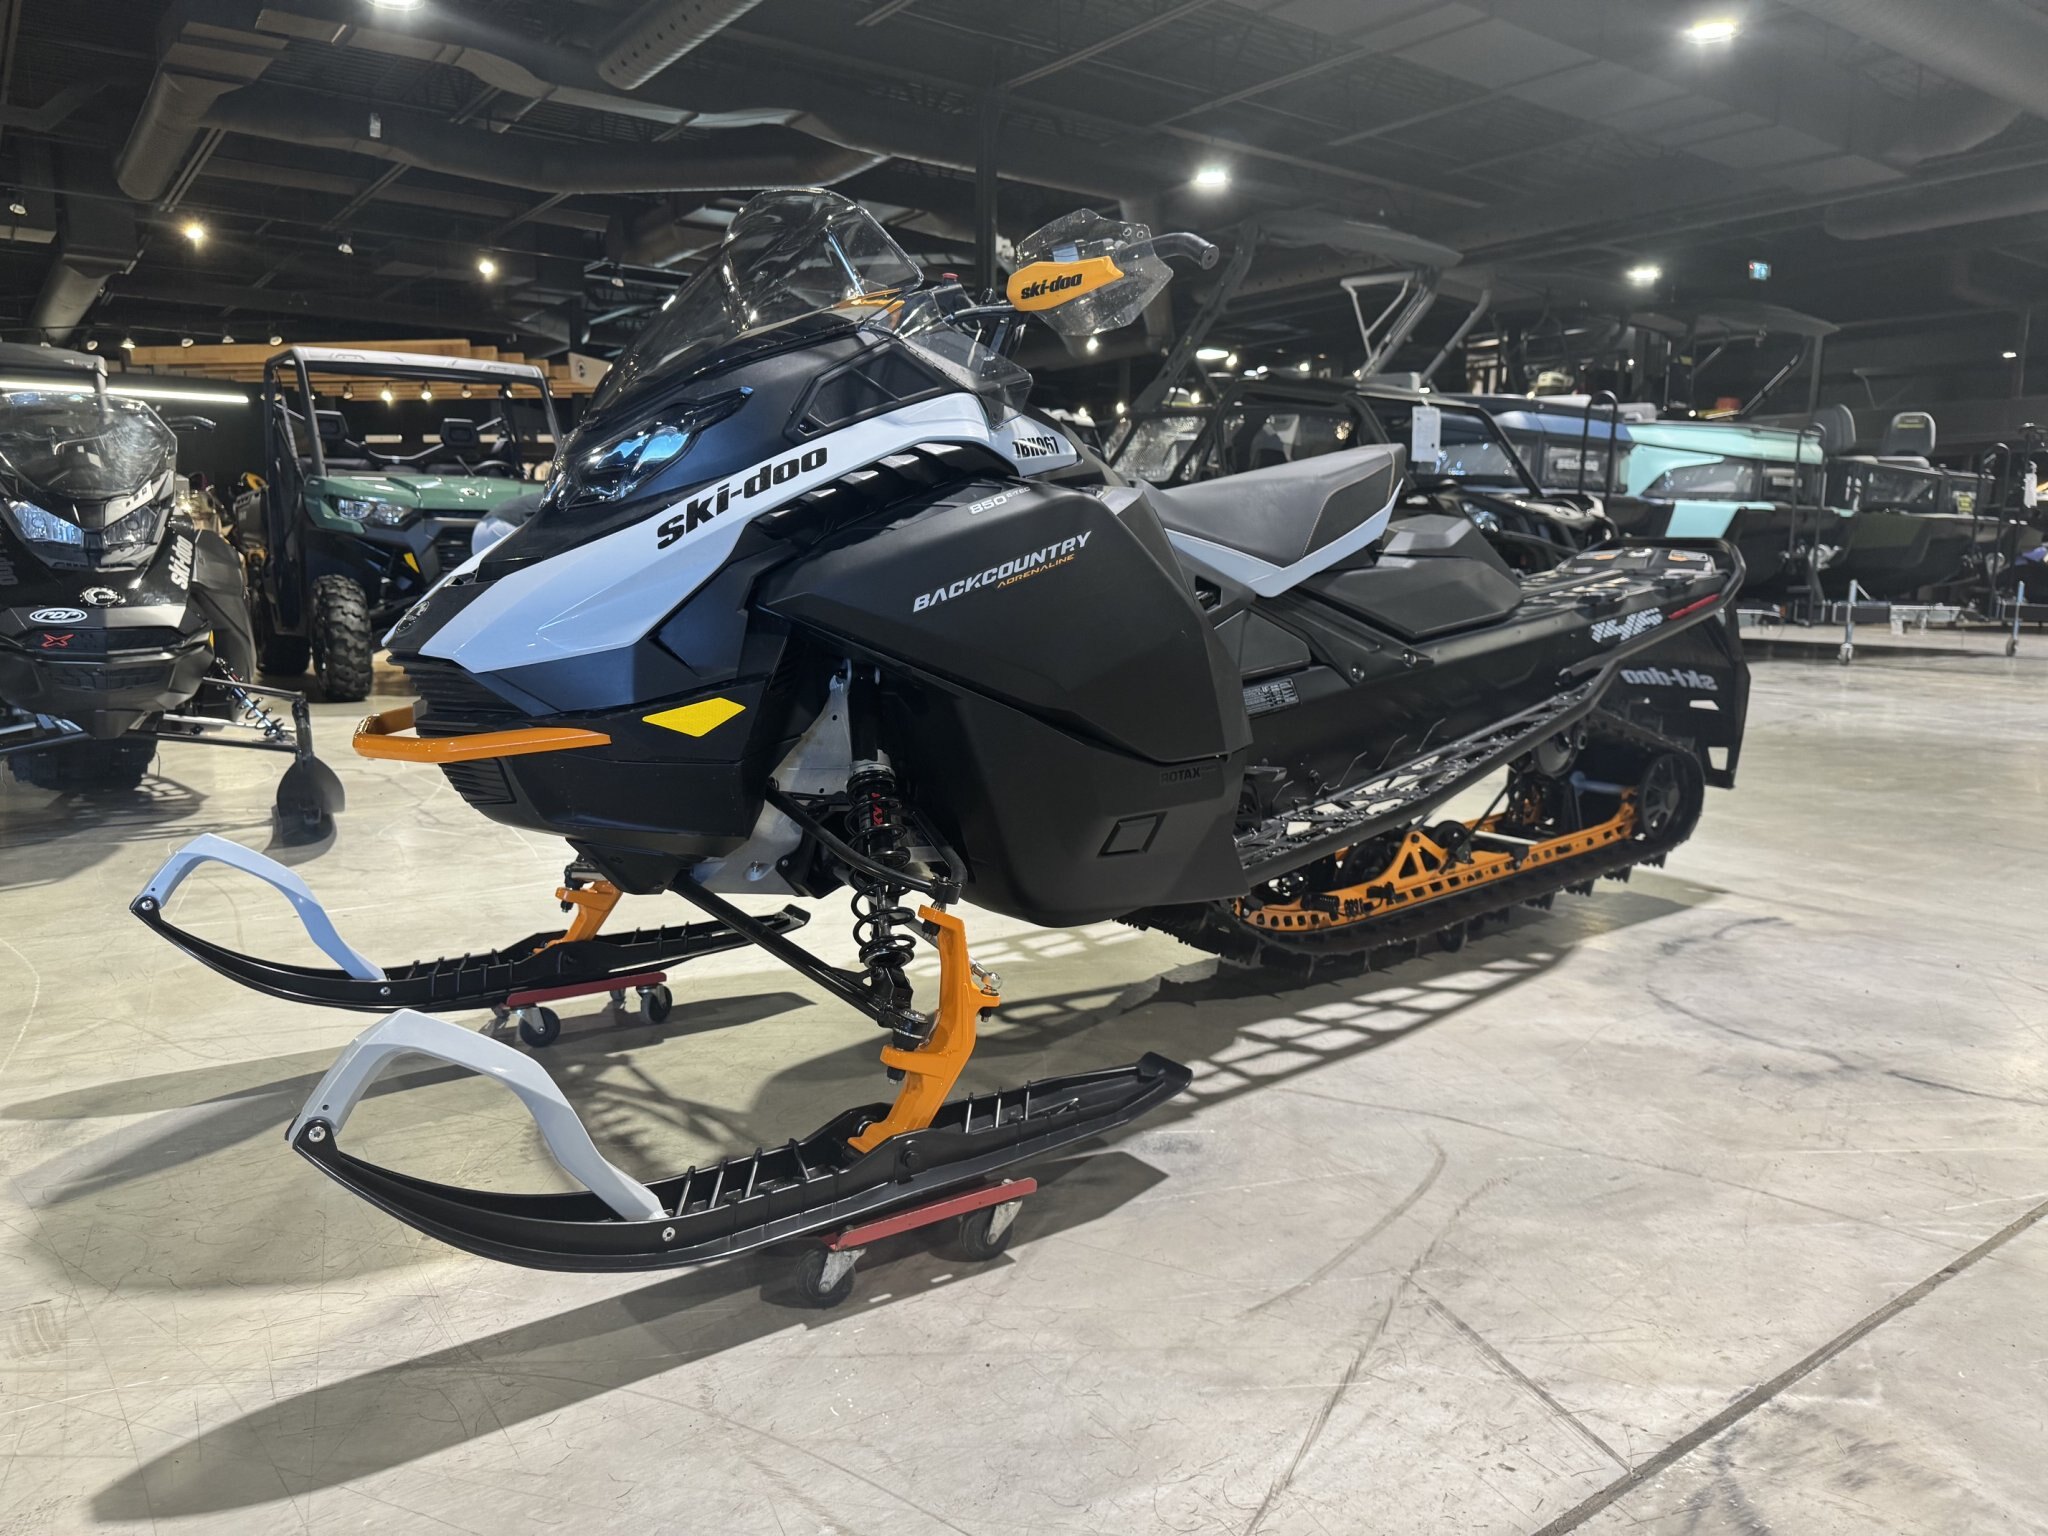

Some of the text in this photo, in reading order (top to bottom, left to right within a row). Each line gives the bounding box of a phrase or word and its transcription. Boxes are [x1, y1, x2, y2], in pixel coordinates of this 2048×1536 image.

[1021, 273, 1083, 299] ski-doo
[657, 447, 828, 550] ski-doo
[969, 495, 1007, 515] 850
[168, 534, 193, 591] ski-doo
[913, 531, 1092, 613] BACKCOUNTRY
[997, 553, 1075, 589] ADRENALINE
[1160, 767, 1201, 784] ROTAX
